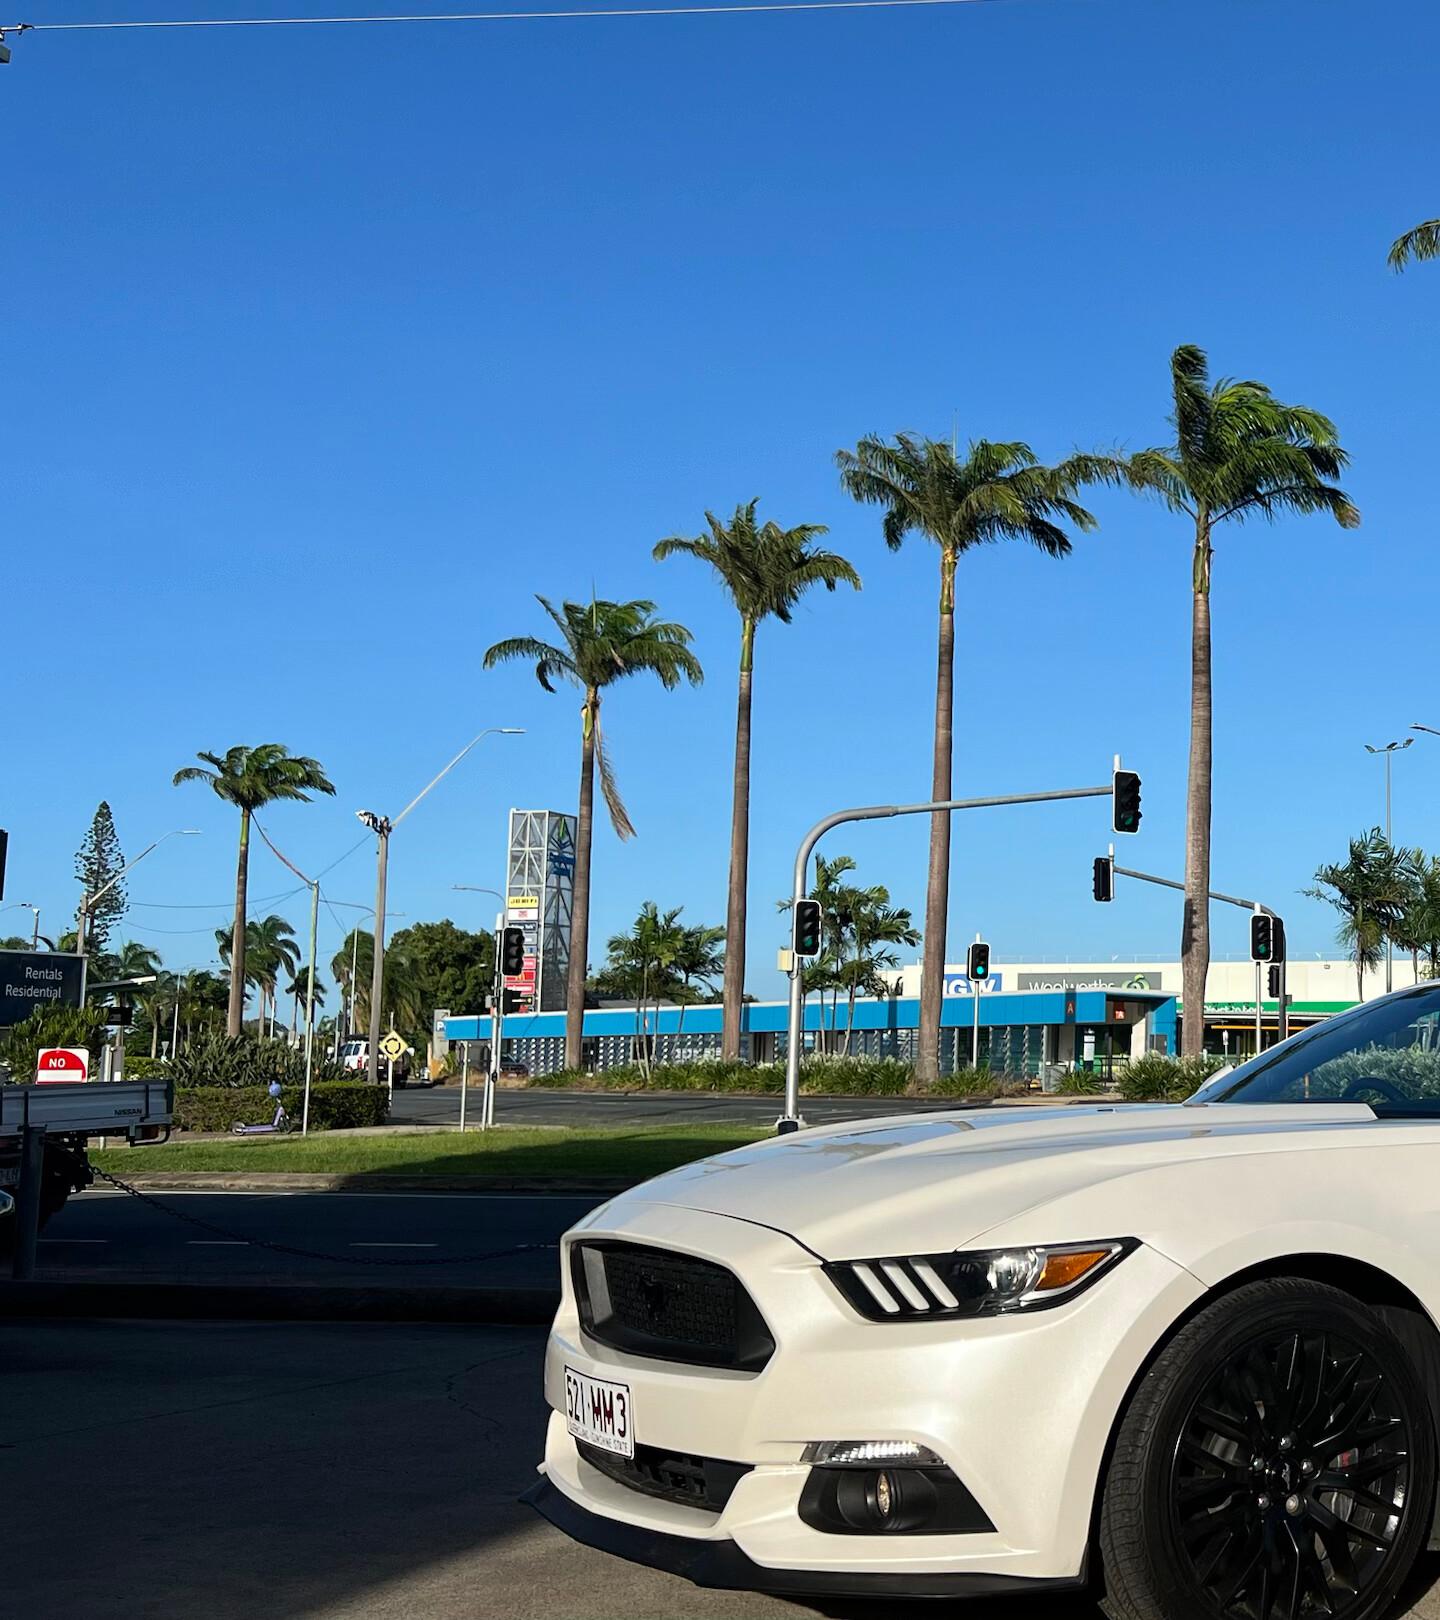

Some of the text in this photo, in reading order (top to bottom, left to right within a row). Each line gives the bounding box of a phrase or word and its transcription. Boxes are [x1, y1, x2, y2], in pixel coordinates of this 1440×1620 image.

[25, 966, 63, 980] Rentals
[5, 984, 62, 998] Residential
[48, 1058, 66, 1068] NO
